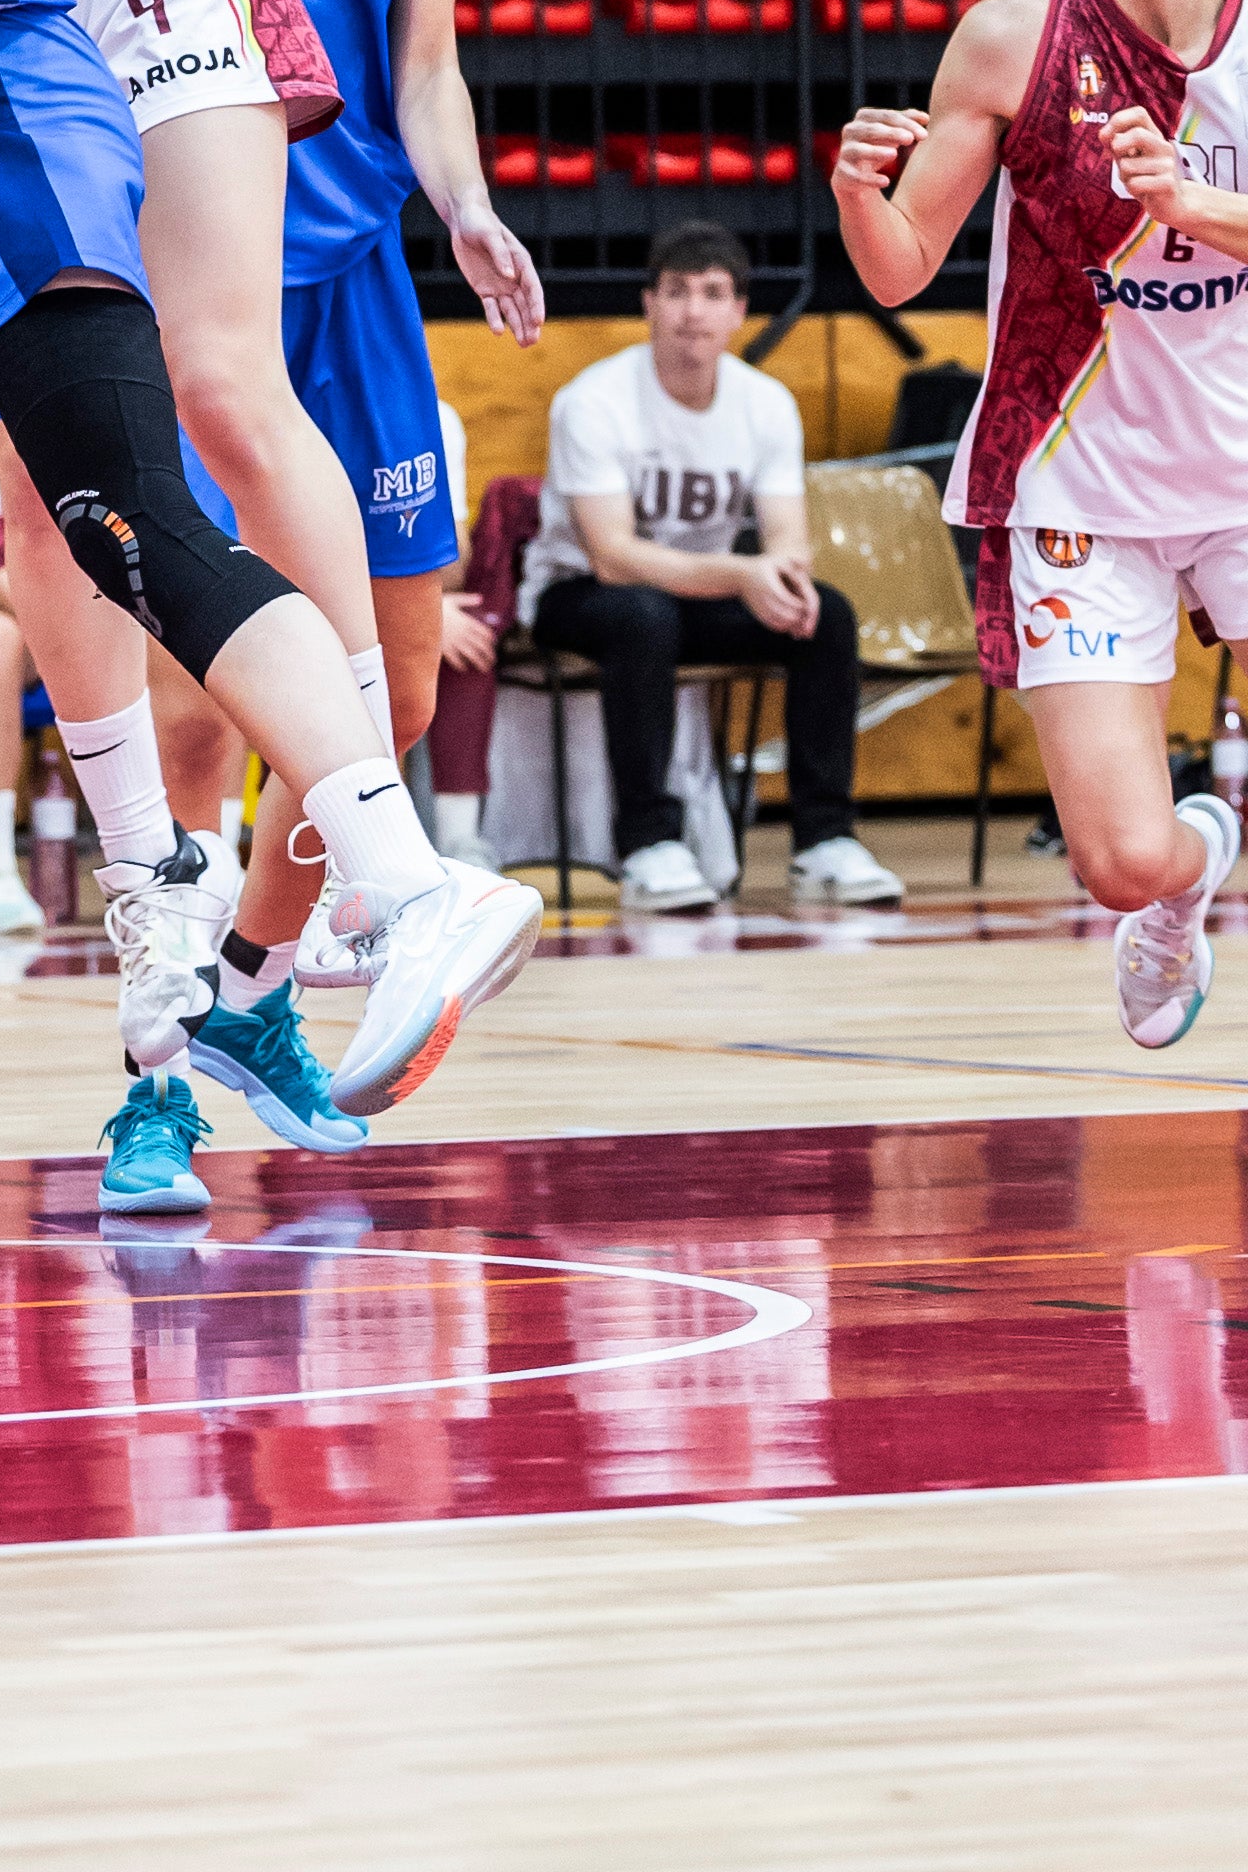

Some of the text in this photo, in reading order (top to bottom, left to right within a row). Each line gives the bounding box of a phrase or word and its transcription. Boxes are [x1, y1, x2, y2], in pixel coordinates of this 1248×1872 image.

[147, 46, 240, 89] RIOJA
[1162, 226, 1196, 263] 6
[373, 451, 436, 501] MB
[1063, 622, 1121, 657] tvr
